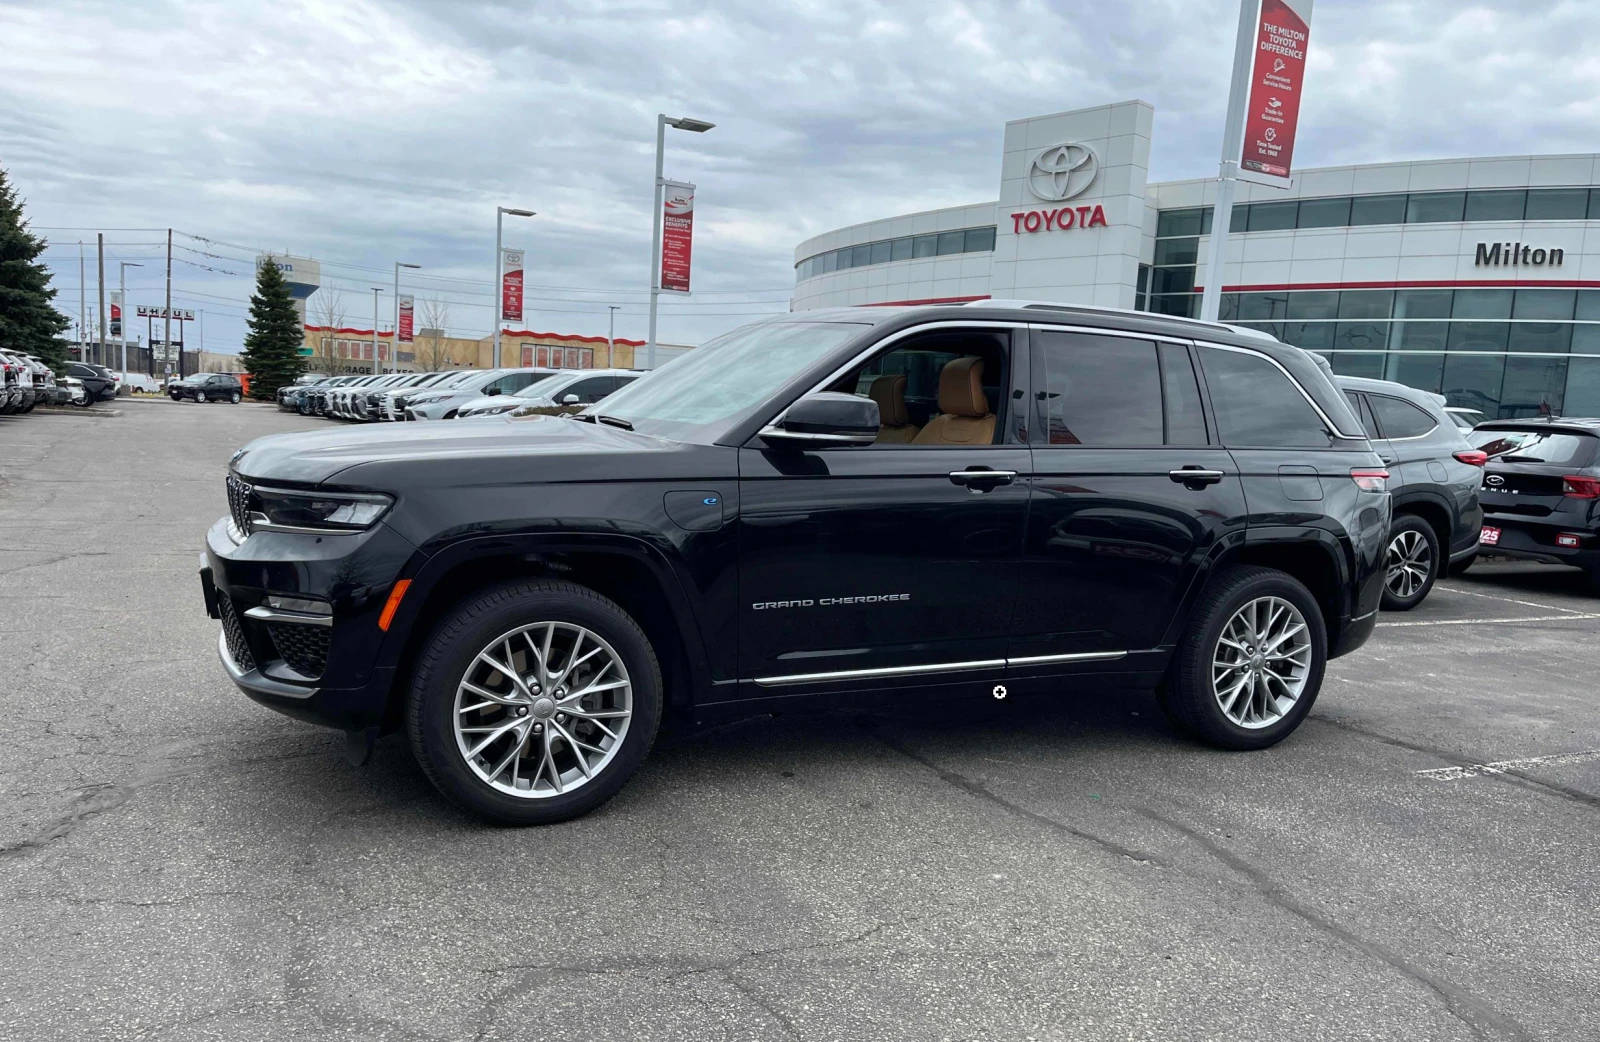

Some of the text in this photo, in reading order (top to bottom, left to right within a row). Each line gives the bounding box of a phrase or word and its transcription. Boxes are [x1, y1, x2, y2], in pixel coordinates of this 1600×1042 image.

[1263, 23, 1305, 41] THE MILTON
[1270, 34, 1296, 48] TOYOTA
[1261, 41, 1302, 59] DIFFERENCE
[1263, 79, 1291, 91] Service Hours
[1266, 73, 1290, 84] Convenient
[1262, 115, 1284, 124] Guarantee
[1256, 140, 1282, 151] Time Tested
[1010, 204, 1107, 234] TOYOTA
[1475, 242, 1564, 265] Milton
[752, 593, 910, 610] GRAND CHEROKEE
